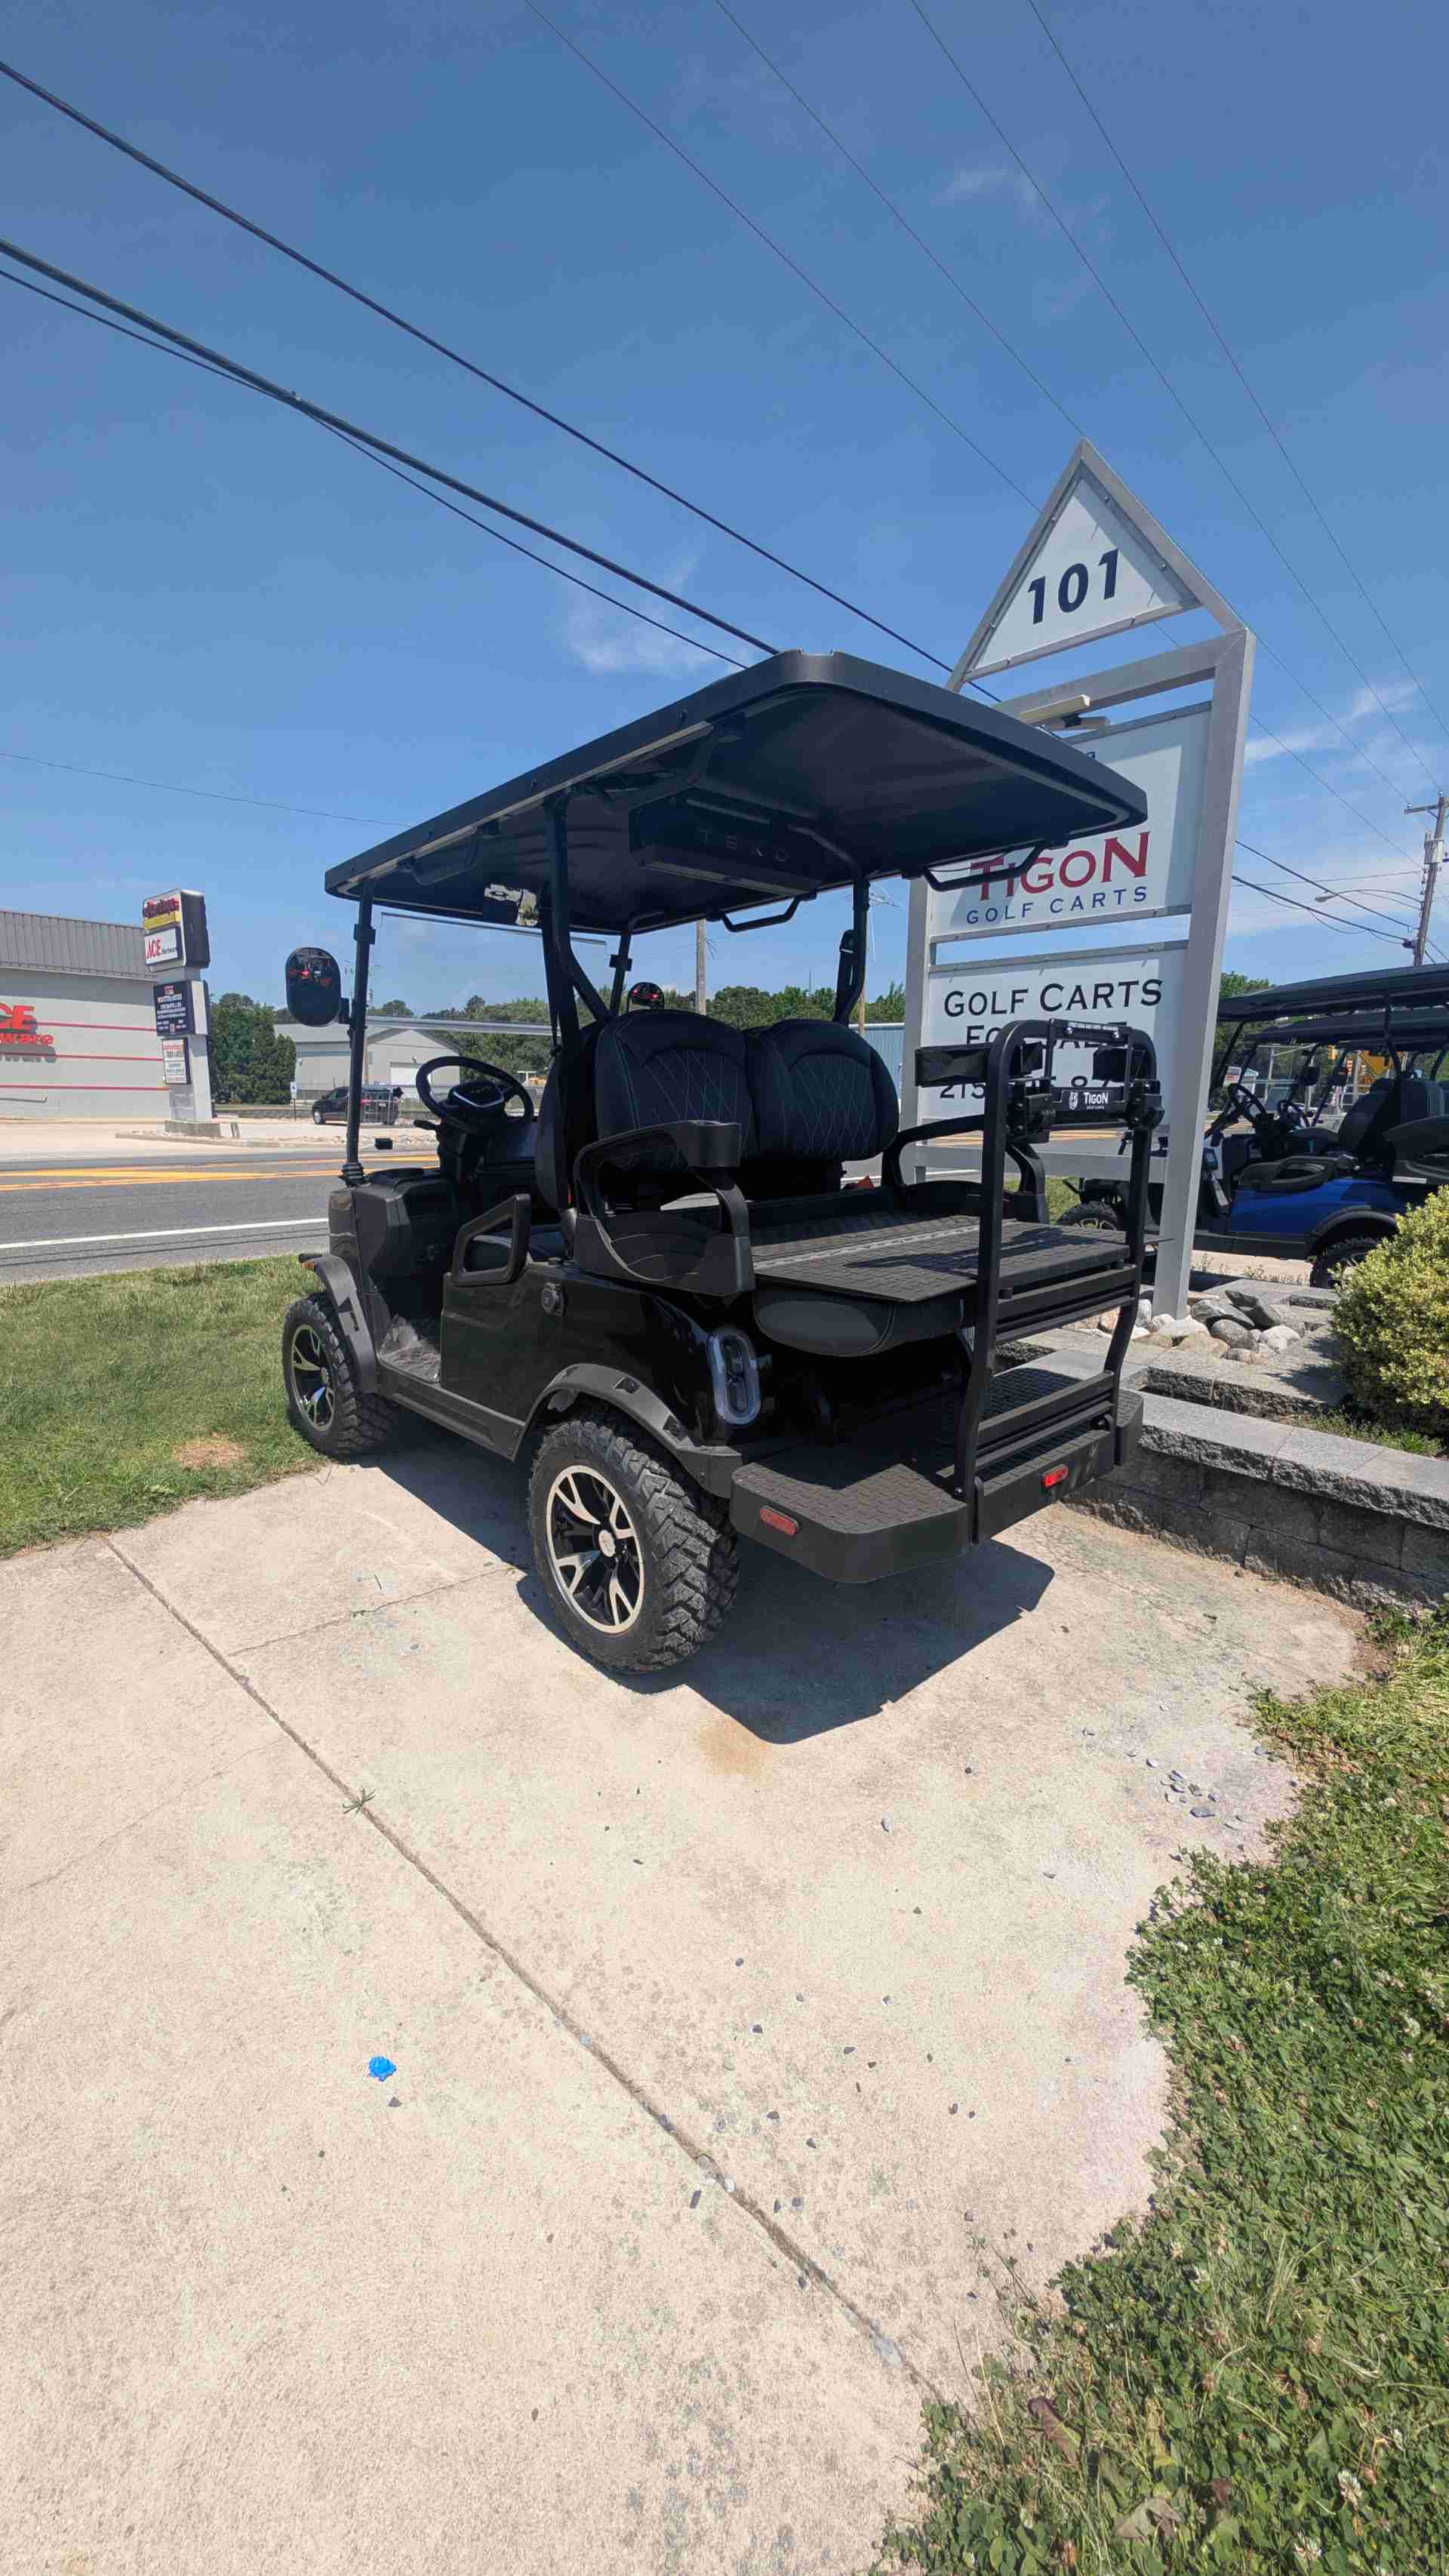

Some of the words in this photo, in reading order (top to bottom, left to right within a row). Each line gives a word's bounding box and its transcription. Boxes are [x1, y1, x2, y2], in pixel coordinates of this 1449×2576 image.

[1027, 548, 1118, 625] 101
[971, 832, 1150, 901] TIGON
[967, 902, 1033, 925] GOLF
[1050, 886, 1147, 914] CARTS
[944, 989, 1029, 1017] GOLF
[1039, 979, 1163, 1012] CARTS
[1083, 1092, 1109, 1104] TIGON
